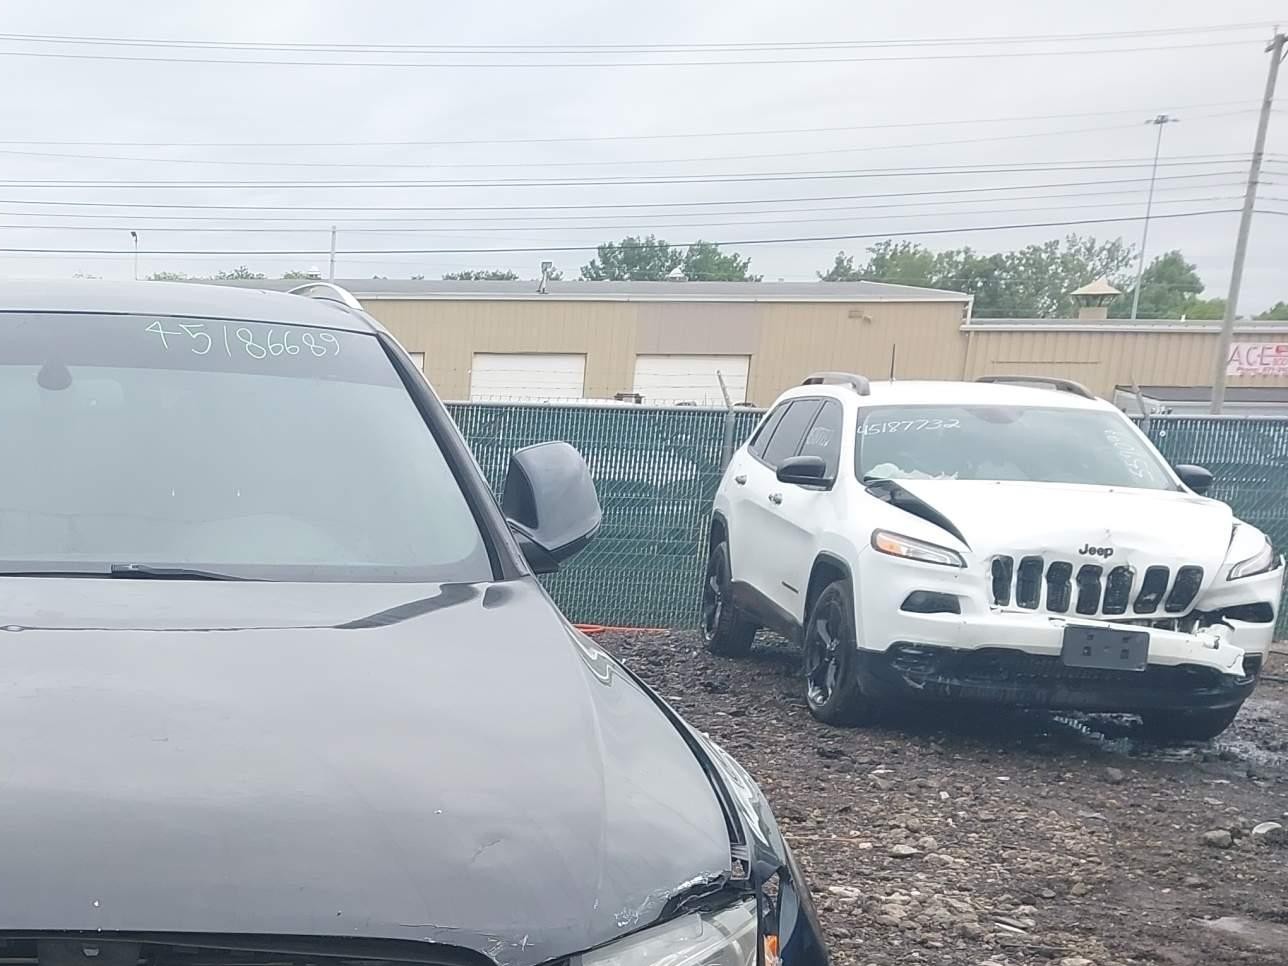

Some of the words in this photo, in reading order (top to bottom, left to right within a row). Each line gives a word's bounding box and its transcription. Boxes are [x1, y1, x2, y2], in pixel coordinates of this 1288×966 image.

[144, 320, 340, 359] 45186689
[857, 418, 961, 435] 45187732
[1078, 543, 1114, 559] Jeep
